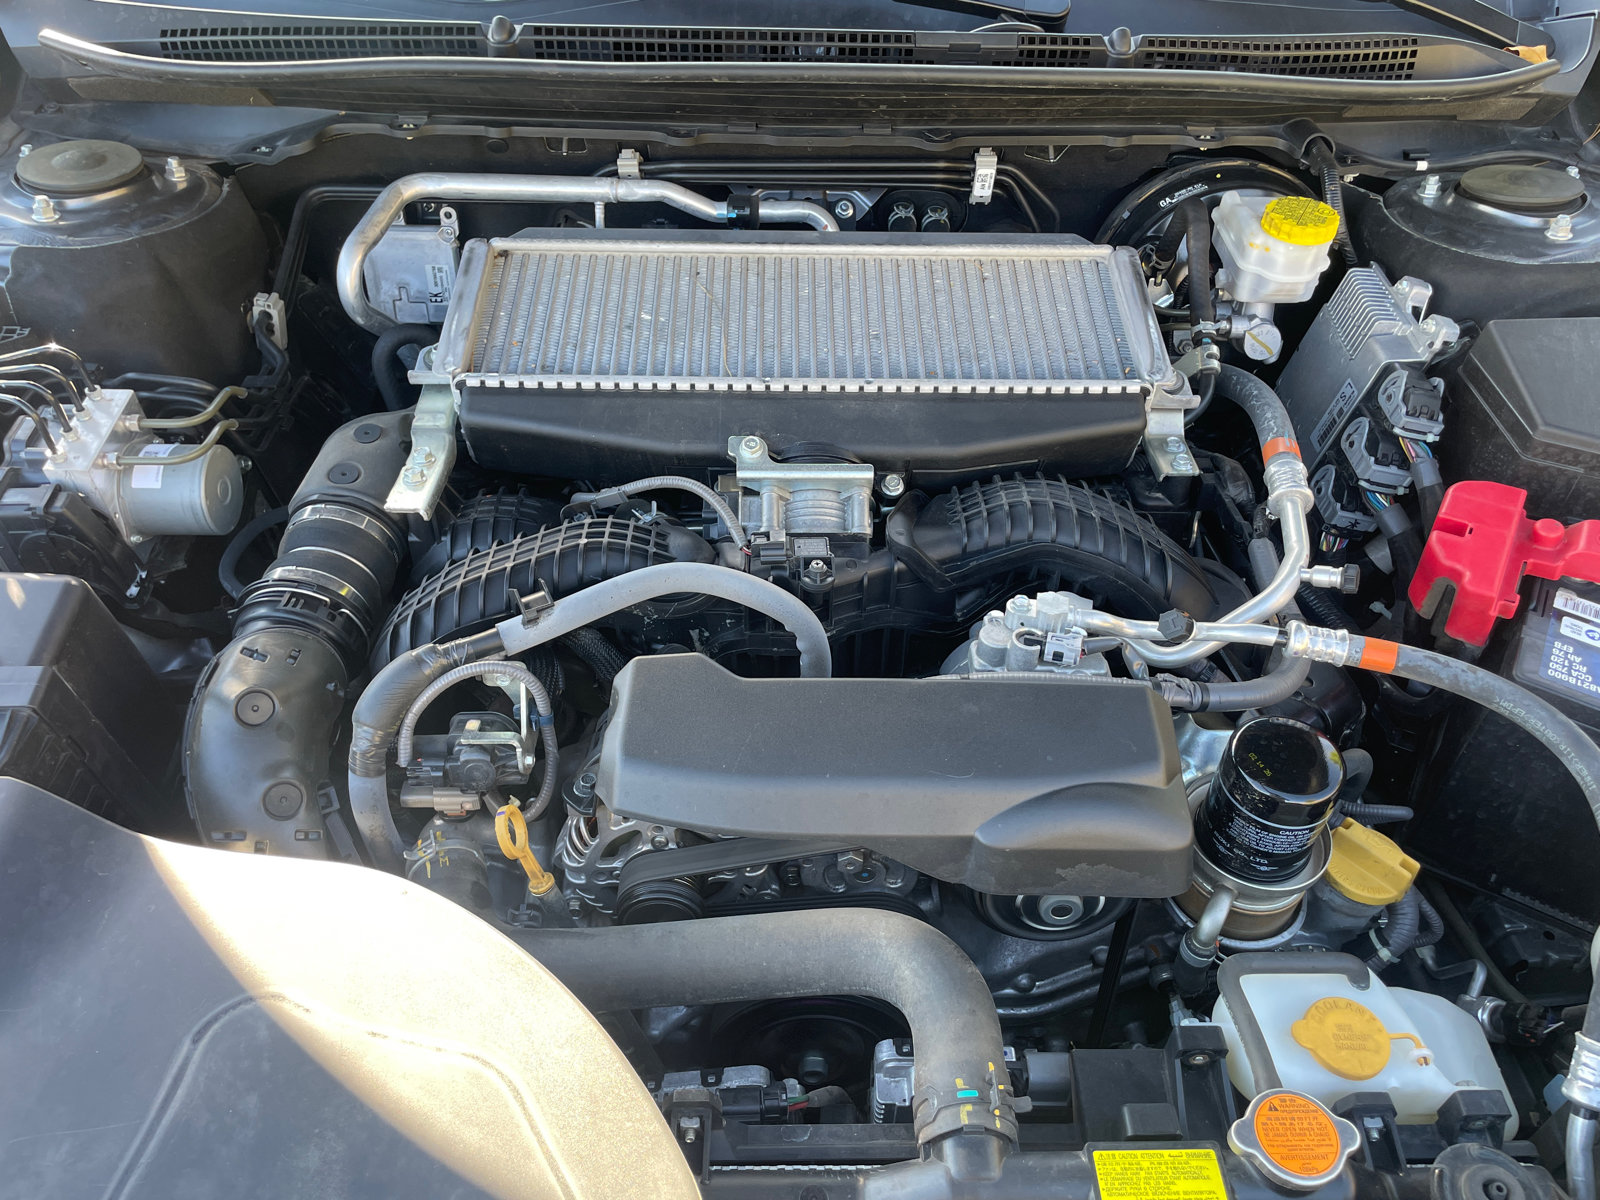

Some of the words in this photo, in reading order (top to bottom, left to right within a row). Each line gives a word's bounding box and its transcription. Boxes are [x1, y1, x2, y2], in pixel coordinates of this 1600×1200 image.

[429, 292, 443, 303] EK
[1552, 648, 1565, 657] 76
[1554, 641, 1574, 653] EFB
[1550, 655, 1569, 666] 120
[1567, 654, 1582, 663] Ah
[1549, 662, 1568, 674] 750
[1572, 663, 1587, 673] RC
[1571, 670, 1592, 682] CCA
